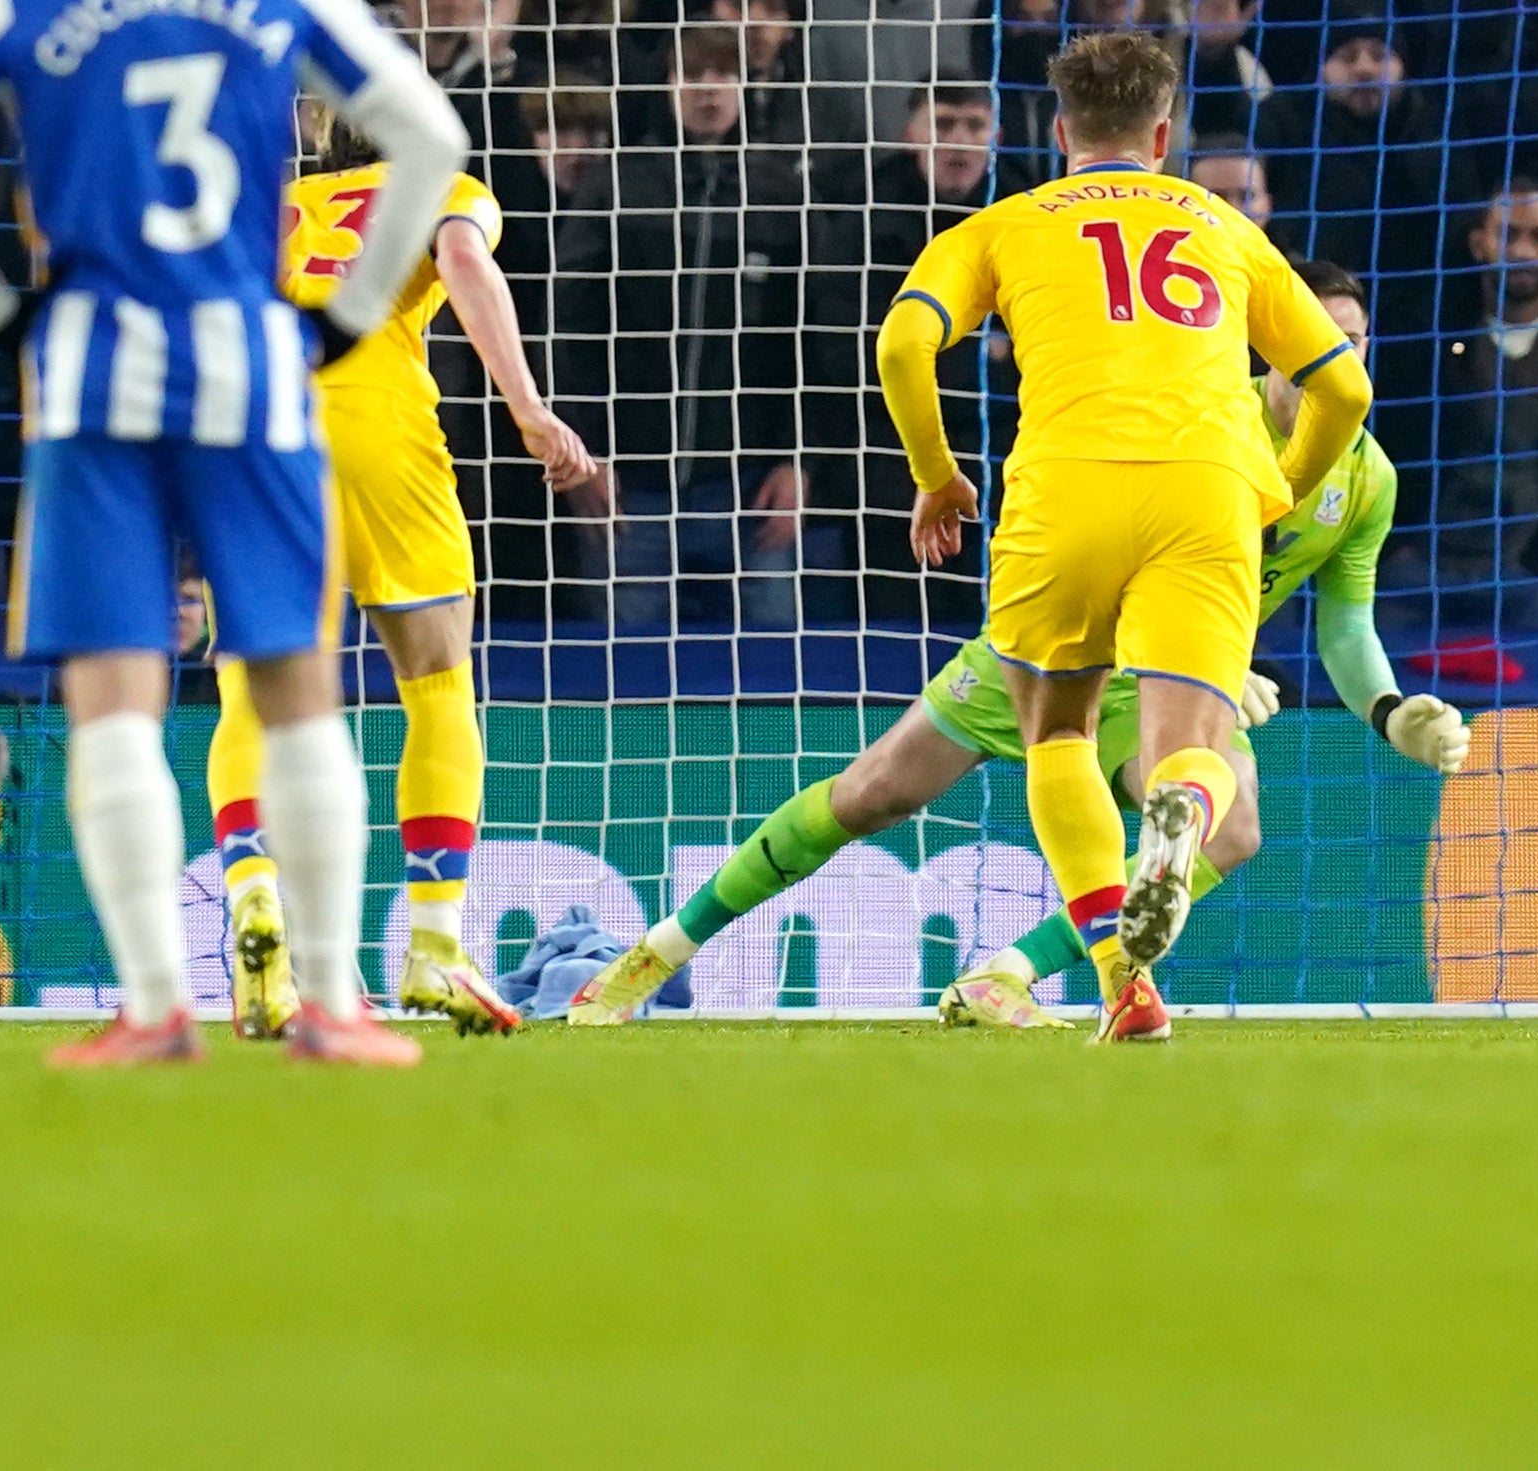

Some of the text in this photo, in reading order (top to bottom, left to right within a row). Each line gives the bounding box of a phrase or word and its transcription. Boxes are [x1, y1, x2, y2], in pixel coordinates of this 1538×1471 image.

[122, 51, 242, 254] 3
[1038, 184, 1220, 226] ANDERSEN
[1080, 221, 1223, 329] 16
